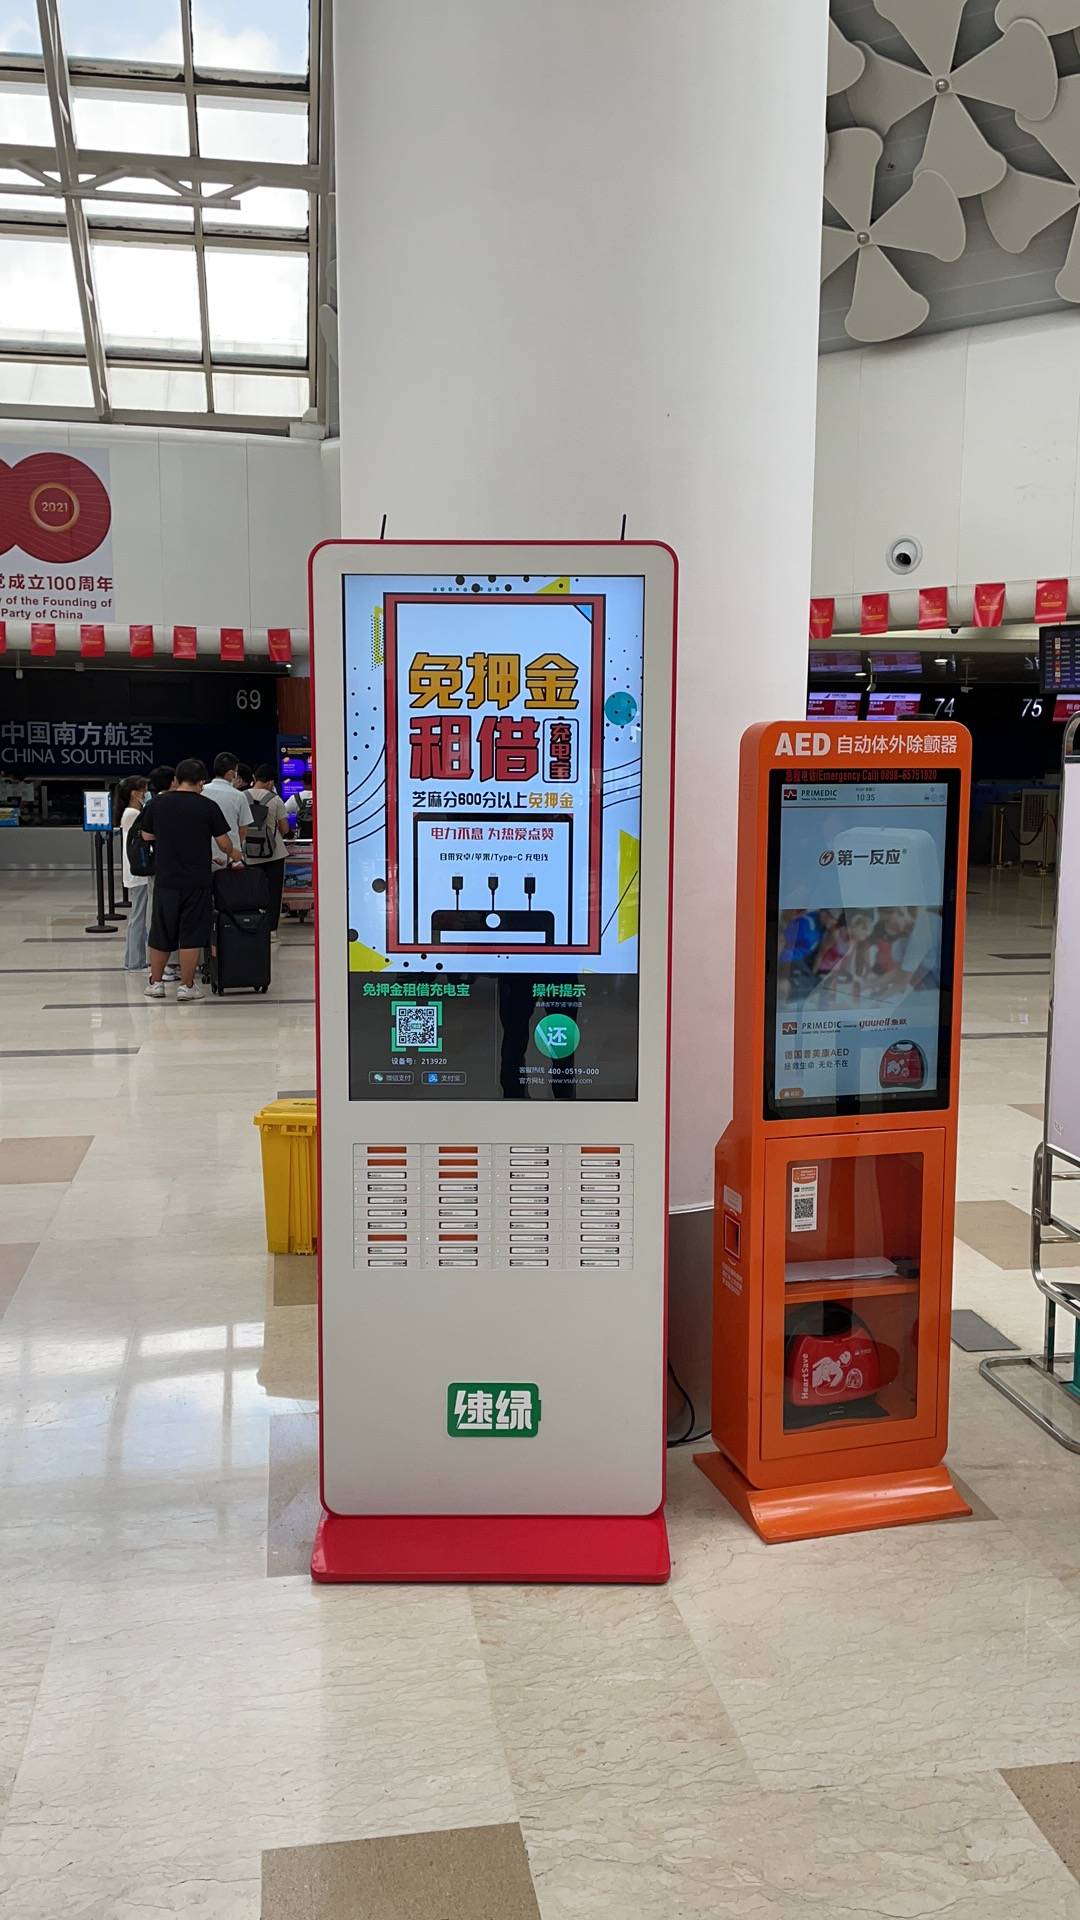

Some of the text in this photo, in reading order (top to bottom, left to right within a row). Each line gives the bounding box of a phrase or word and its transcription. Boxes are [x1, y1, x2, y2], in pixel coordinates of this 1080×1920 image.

[42, 501, 68, 512] 2021
[6, 596, 112, 609] of the Founding of
[1, 608, 83, 620] Party of China
[409, 652, 579, 710] 免押金
[236, 689, 262, 710] 69
[934, 697, 955, 718] 74
[1022, 698, 1043, 717] 75
[1, 721, 153, 746] 中国南方航空
[410, 715, 541, 782] 租借
[775, 732, 958, 756] AED 自动体外除颤器
[1, 748, 153, 765] CHINA SOUTHERN
[801, 789, 838, 797] PRIMEDIC
[431, 827, 484, 840] 电力不息
[837, 849, 900, 866] 第一反应
[363, 982, 470, 997] 免押金租借充电宝
[532, 983, 587, 998] 操作提示
[801, 1020, 842, 1030] PRIMEDIC
[547, 1026, 567, 1047] 还
[801, 1353, 809, 1400] HeartSave
[454, 1390, 532, 1430] 速绿
